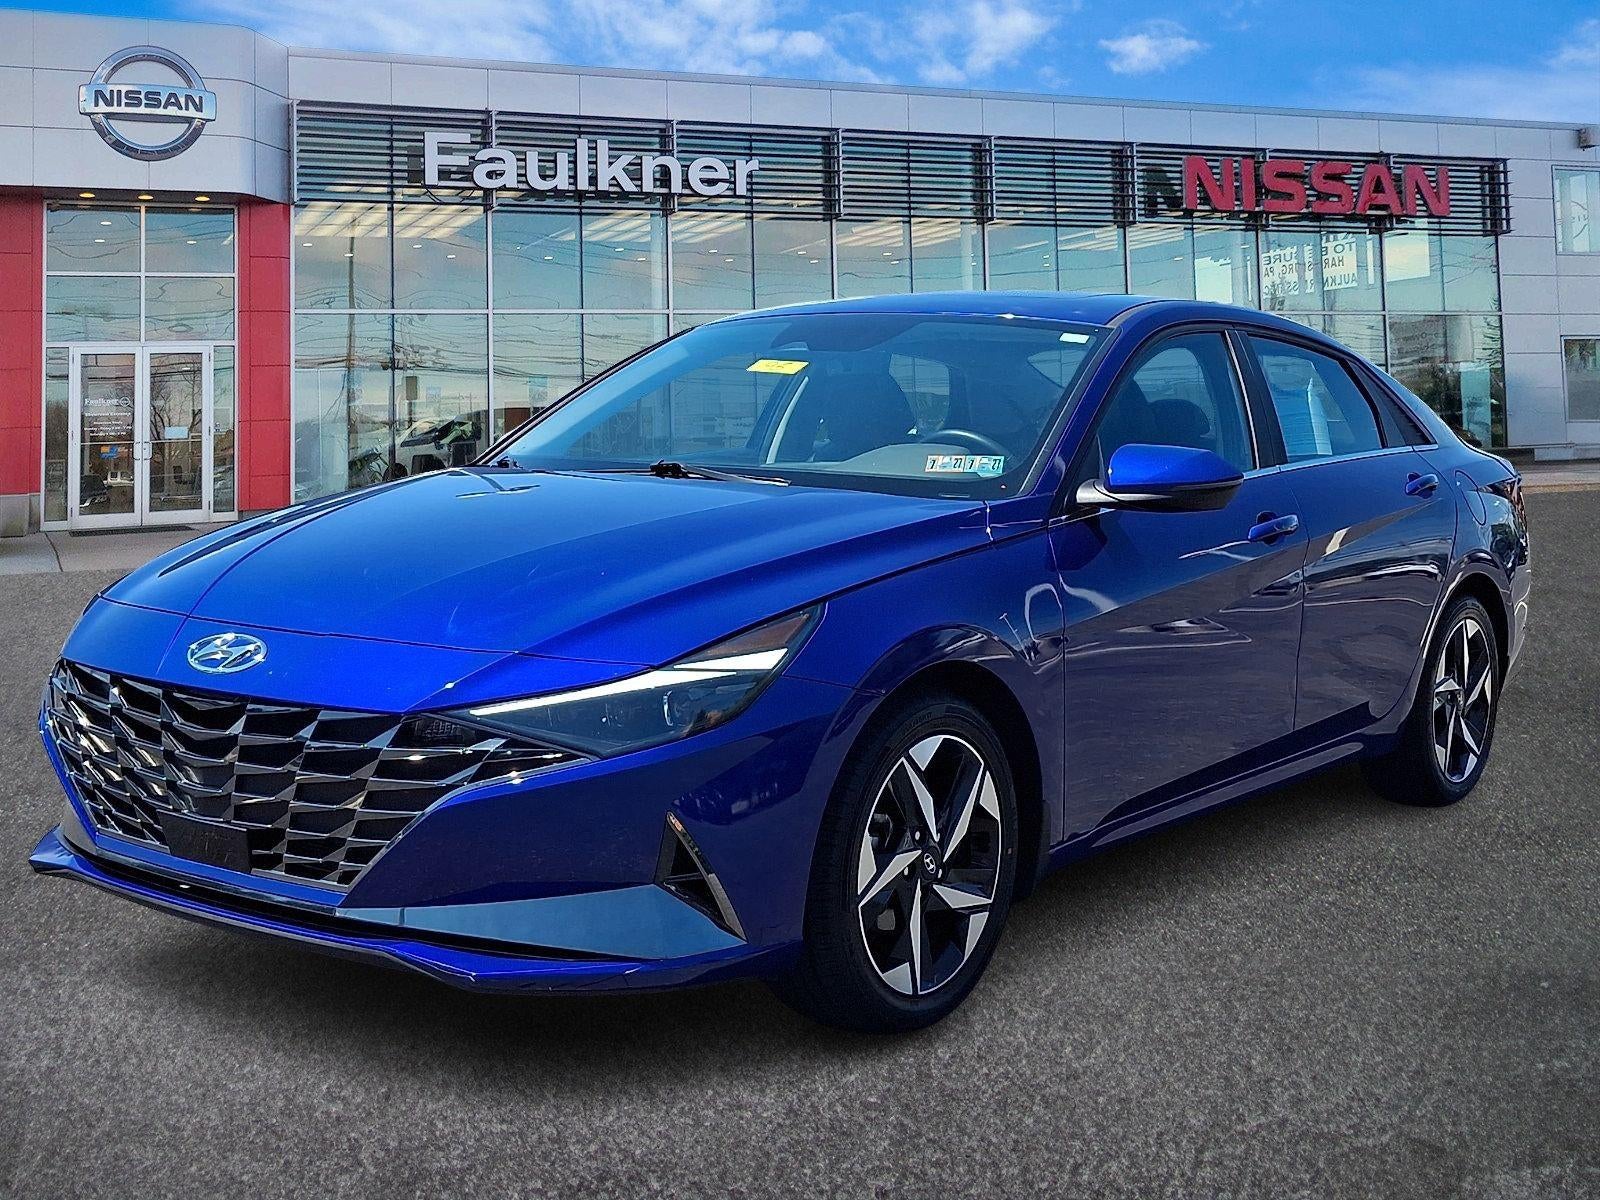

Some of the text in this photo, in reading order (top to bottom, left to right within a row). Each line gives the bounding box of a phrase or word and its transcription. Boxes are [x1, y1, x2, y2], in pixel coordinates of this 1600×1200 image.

[93, 89, 204, 113] NISSAN
[423, 131, 760, 196] Faulkner
[1182, 155, 1451, 216] NISSAN
